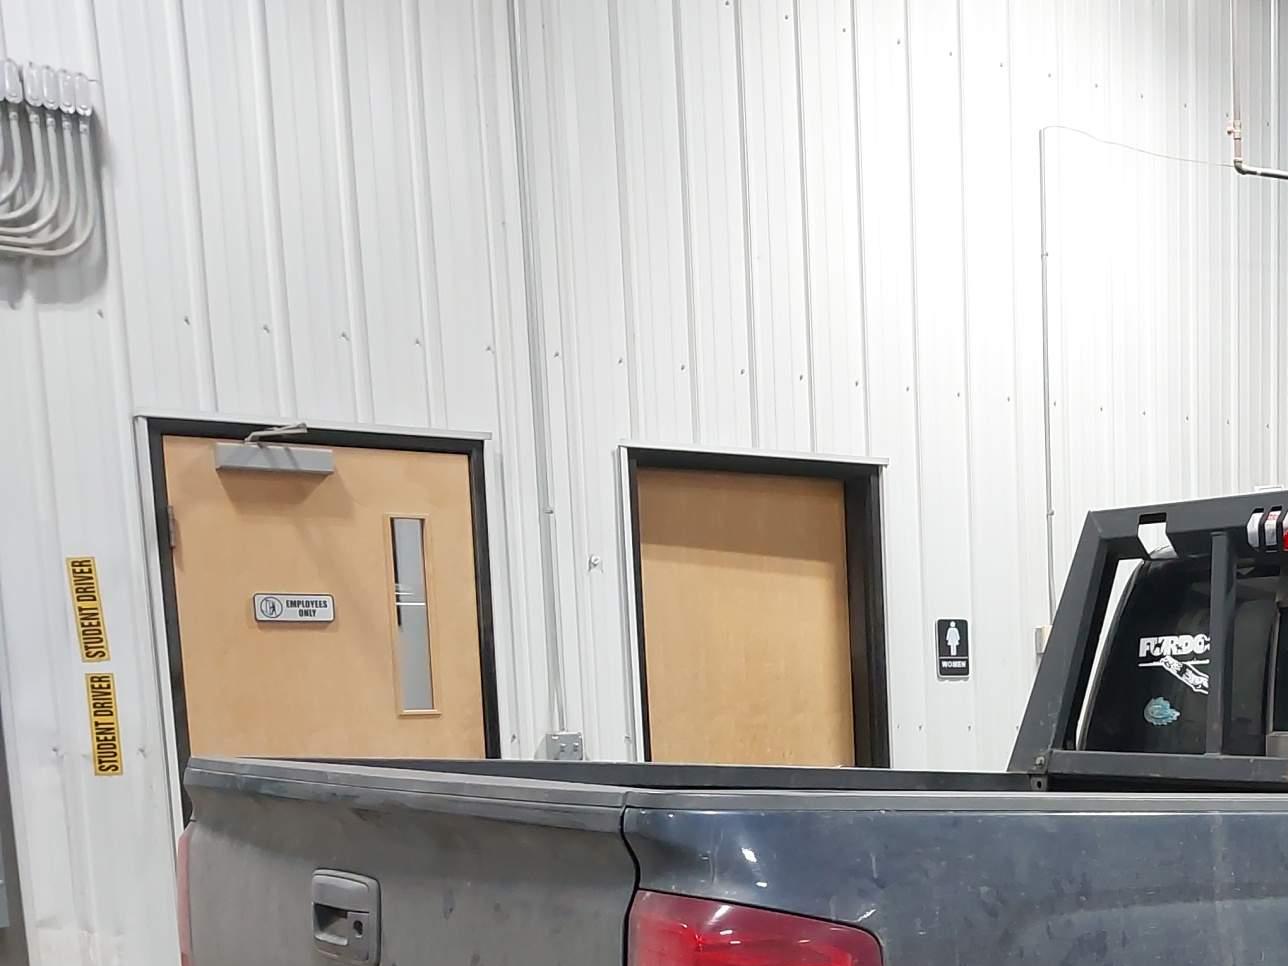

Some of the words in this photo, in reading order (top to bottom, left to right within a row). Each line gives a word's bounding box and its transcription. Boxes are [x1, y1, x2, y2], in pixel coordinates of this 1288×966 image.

[71, 559, 97, 602] DRIVER
[285, 599, 328, 609] EMPLOYEES
[298, 609, 317, 617] ONLY
[78, 606, 106, 658] STUDENT
[941, 660, 967, 668] WOMEN
[89, 675, 114, 717] DRIVER
[94, 721, 119, 772] STUDENT
